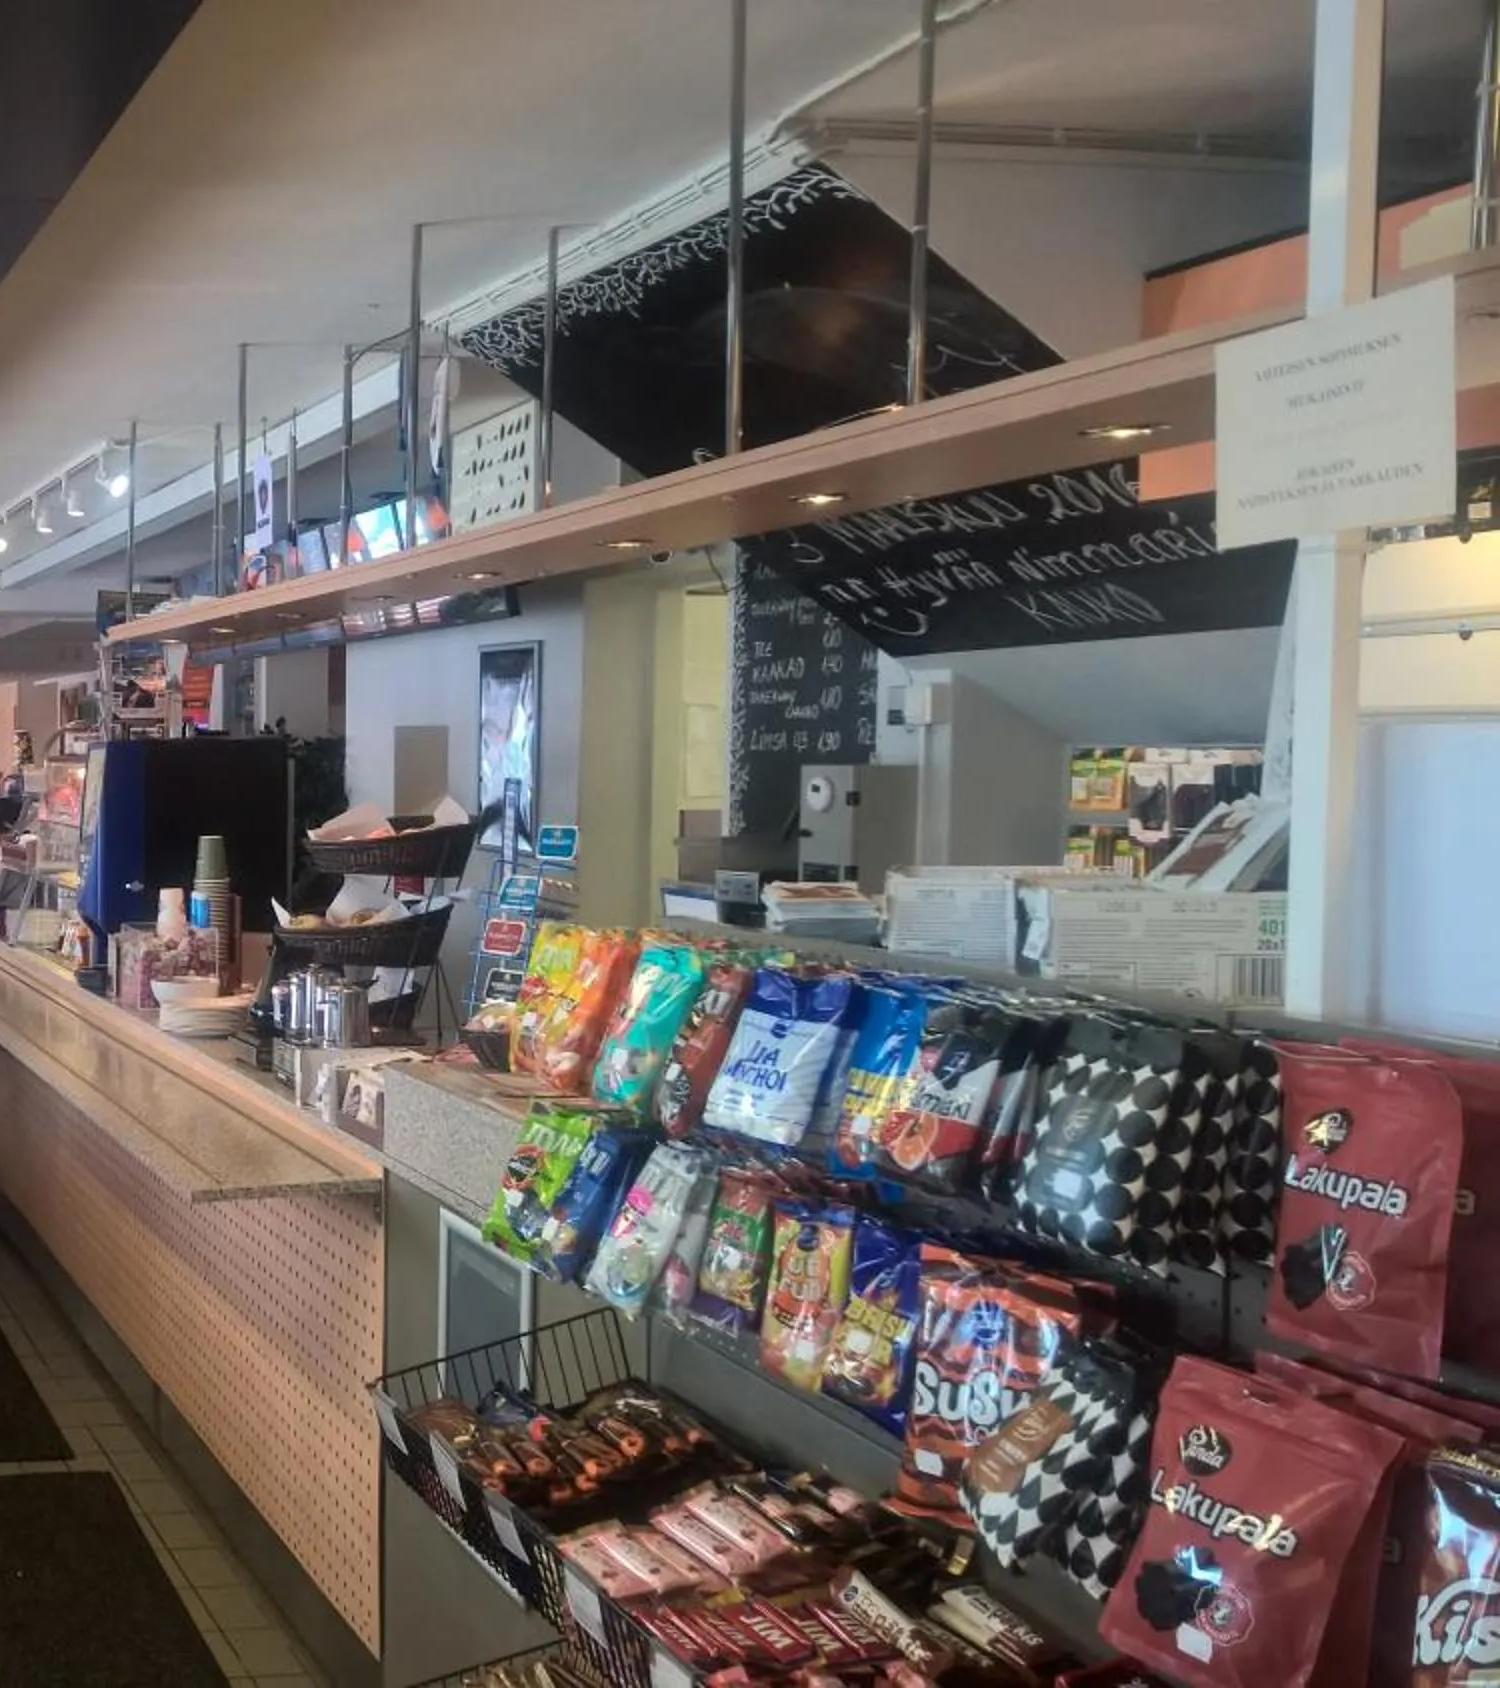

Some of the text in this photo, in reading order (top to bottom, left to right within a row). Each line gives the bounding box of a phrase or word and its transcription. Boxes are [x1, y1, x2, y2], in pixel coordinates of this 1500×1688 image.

[1284, 1153, 1408, 1217] Lakupala
[1151, 1469, 1298, 1557] Lakupala
[739, 1614, 795, 1650] JIM
